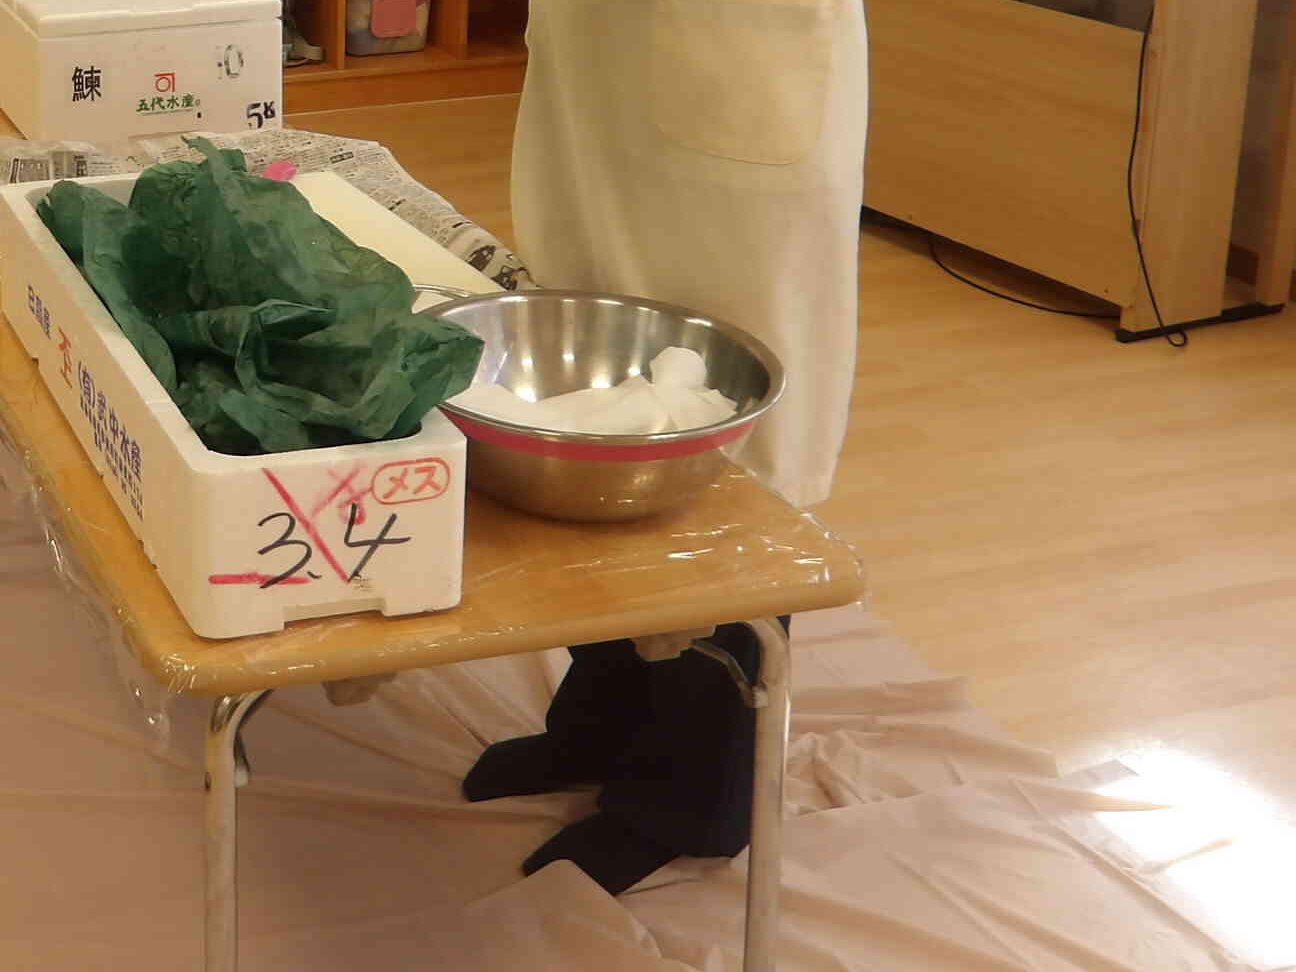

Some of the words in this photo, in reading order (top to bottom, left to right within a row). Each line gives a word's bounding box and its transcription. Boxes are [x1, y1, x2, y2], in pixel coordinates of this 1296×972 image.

[136, 93, 195, 112] 五代水産
[382, 465, 442, 500] メス
